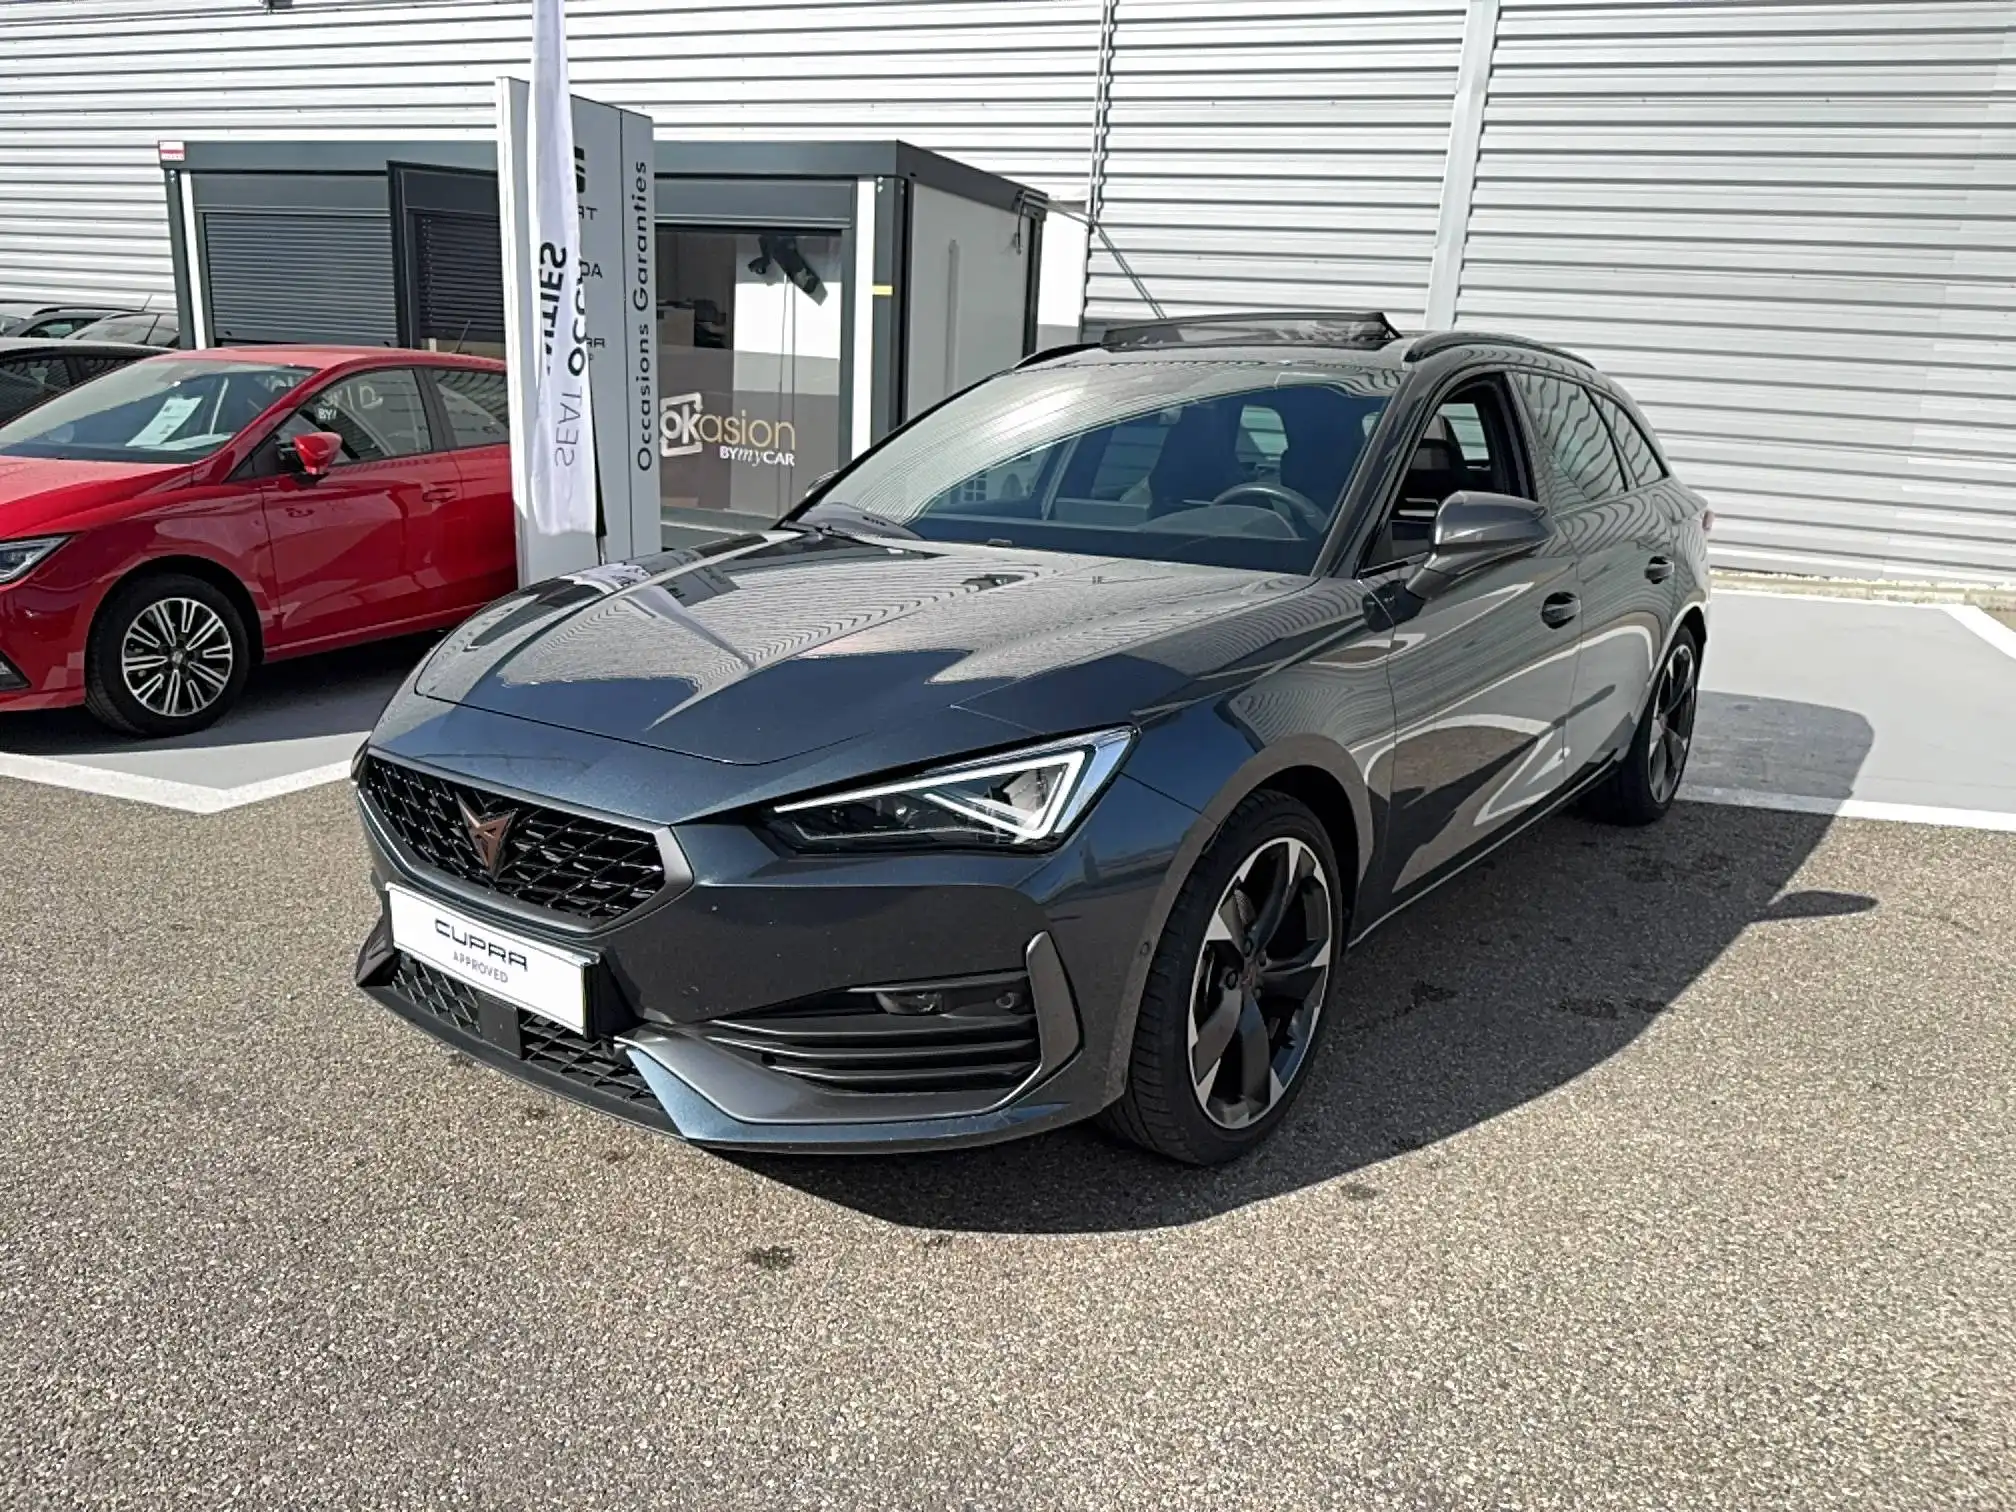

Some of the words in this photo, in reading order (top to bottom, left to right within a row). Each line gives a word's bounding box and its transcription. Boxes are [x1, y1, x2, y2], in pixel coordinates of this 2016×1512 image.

[632, 161, 649, 312] Garanties
[636, 323, 653, 471] Occasions
[659, 403, 796, 451] okasion
[719, 445, 796, 468] BYmyCAR
[434, 918, 529, 972] CUPRA
[452, 951, 509, 984] APPROVED
